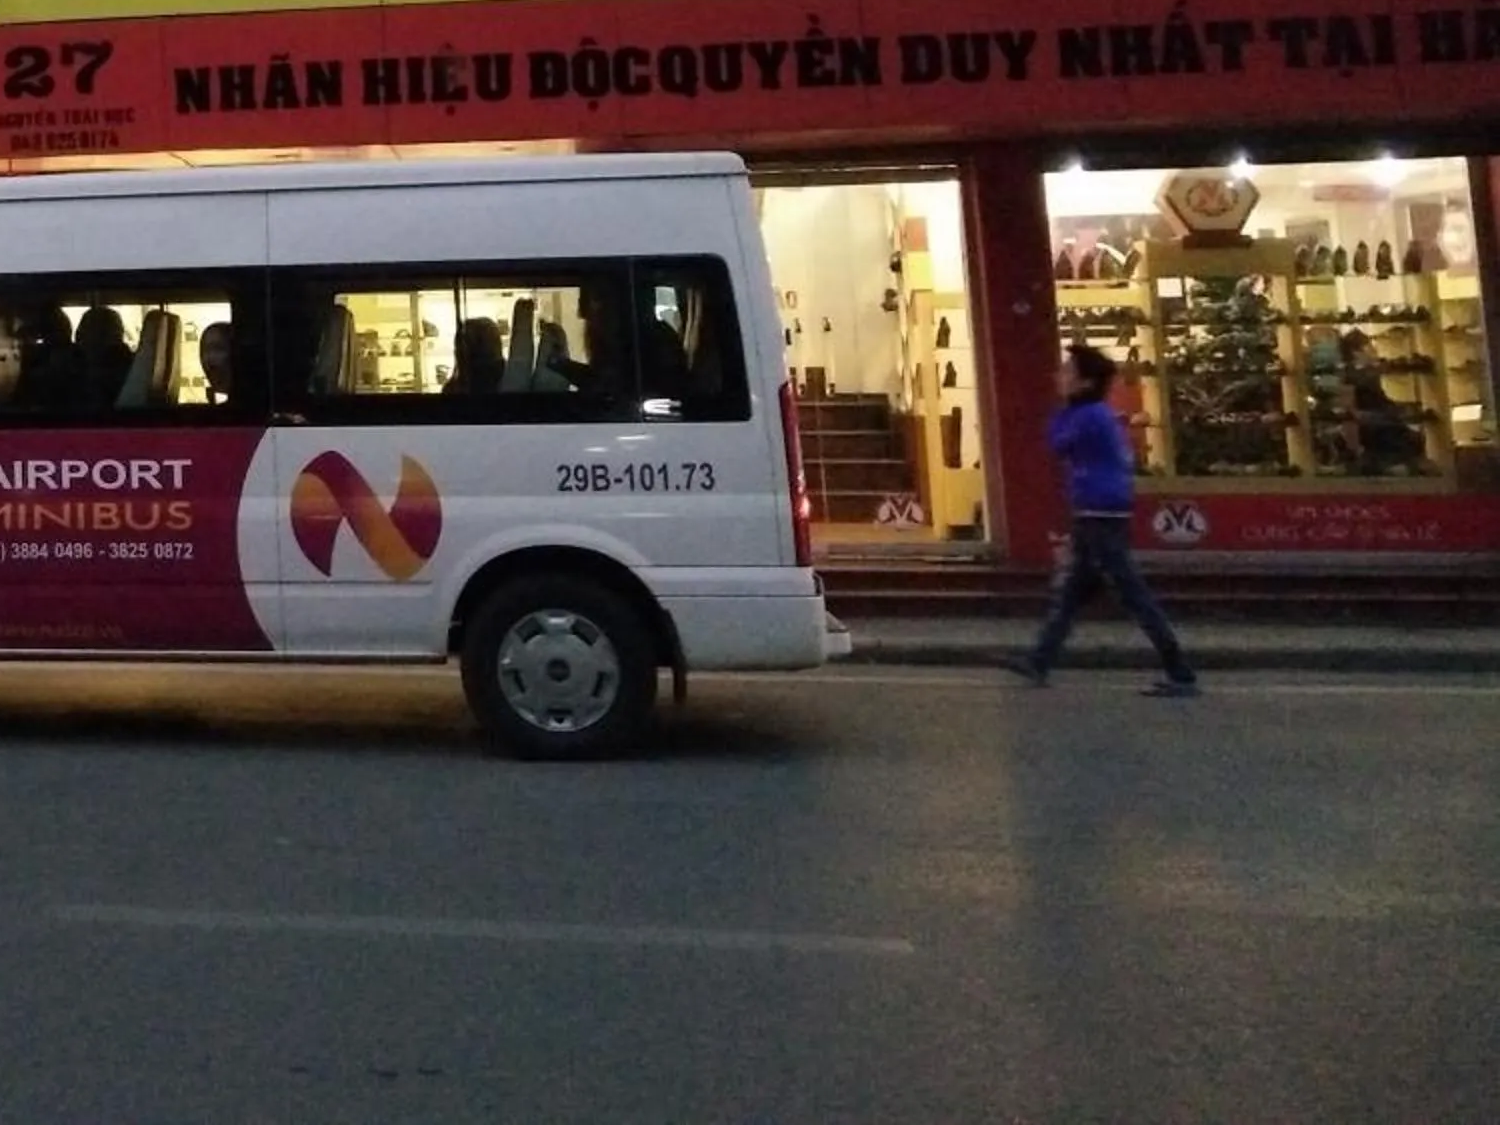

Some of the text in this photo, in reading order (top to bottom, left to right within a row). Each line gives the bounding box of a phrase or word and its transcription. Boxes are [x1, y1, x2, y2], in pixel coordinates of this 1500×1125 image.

[4, 39, 114, 100] 27
[174, 51, 343, 115] NHÃN
[361, 42, 513, 117] HIỆU
[898, 29, 1037, 85] DUY
[1265, 12, 1397, 78] TẠI
[556, 461, 717, 492] 29B-101.73
[11, 542, 49, 559] 3884
[55, 542, 94, 559] 0496
[109, 542, 148, 559] 3825
[153, 542, 194, 559] 0872
